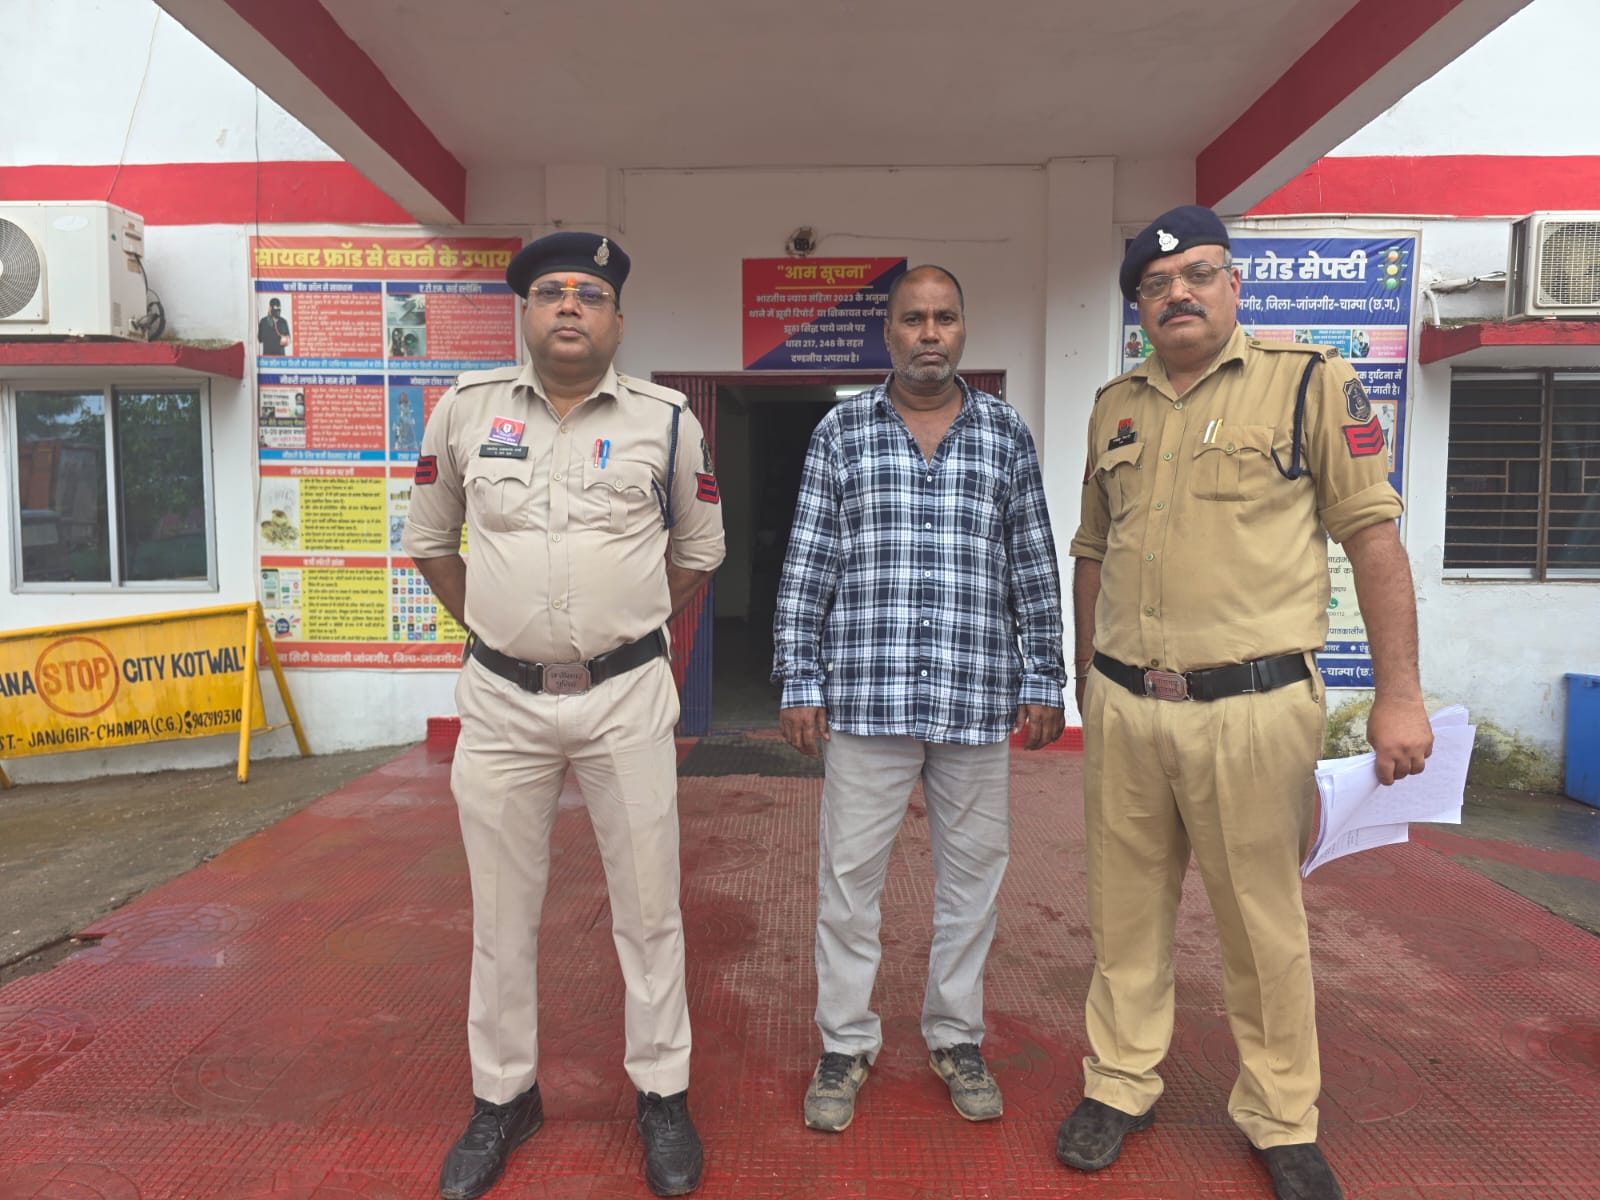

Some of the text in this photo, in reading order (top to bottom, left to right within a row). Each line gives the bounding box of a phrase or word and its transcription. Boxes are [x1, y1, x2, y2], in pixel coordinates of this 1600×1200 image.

[254, 243, 512, 268] सायबर फ्रॉड से बचने के उपाय
[1254, 250, 1295, 280] रोड
[778, 264, 872, 284] "आम सूचना"
[865, 294, 888, 304] अनुसा
[393, 651, 462, 664] जिला-जांजगीर-
[0, 670, 36, 697] ANA
[42, 656, 110, 696] STOP
[122, 655, 165, 683] CITY
